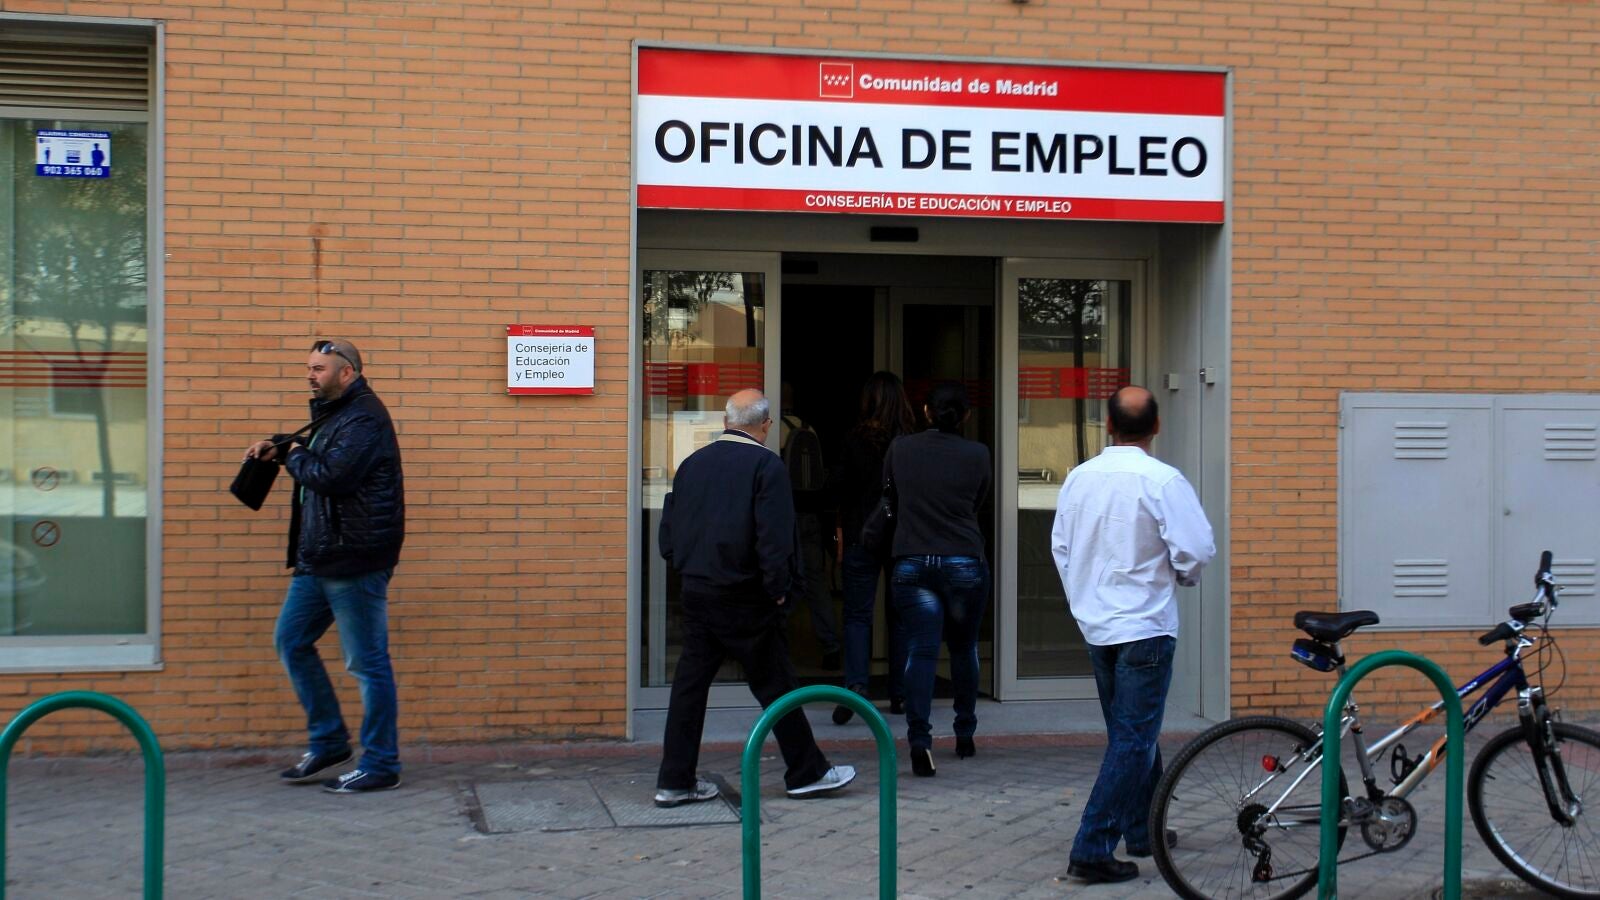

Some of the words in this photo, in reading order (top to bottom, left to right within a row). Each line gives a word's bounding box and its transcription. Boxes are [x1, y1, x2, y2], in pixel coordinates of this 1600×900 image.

[859, 73, 963, 94] Comunidad
[968, 78, 990, 94] de
[996, 79, 1058, 97] Madrid
[655, 119, 884, 169] OFICINA
[901, 128, 972, 171] DE
[991, 130, 1208, 178] EMPLEO
[43, 166, 62, 175] 902
[64, 166, 82, 175] 365
[83, 167, 103, 176] 060
[805, 194, 894, 210] CONSEJERÍA
[897, 197, 916, 210] DE
[919, 196, 1001, 212] EDUCACIÓN
[1004, 199, 1013, 212] Y
[1015, 200, 1072, 213] EMPLEO
[575, 343, 588, 353] de
[515, 356, 570, 366] Educación
[515, 371, 522, 381] y
[525, 369, 565, 381] Empleo
